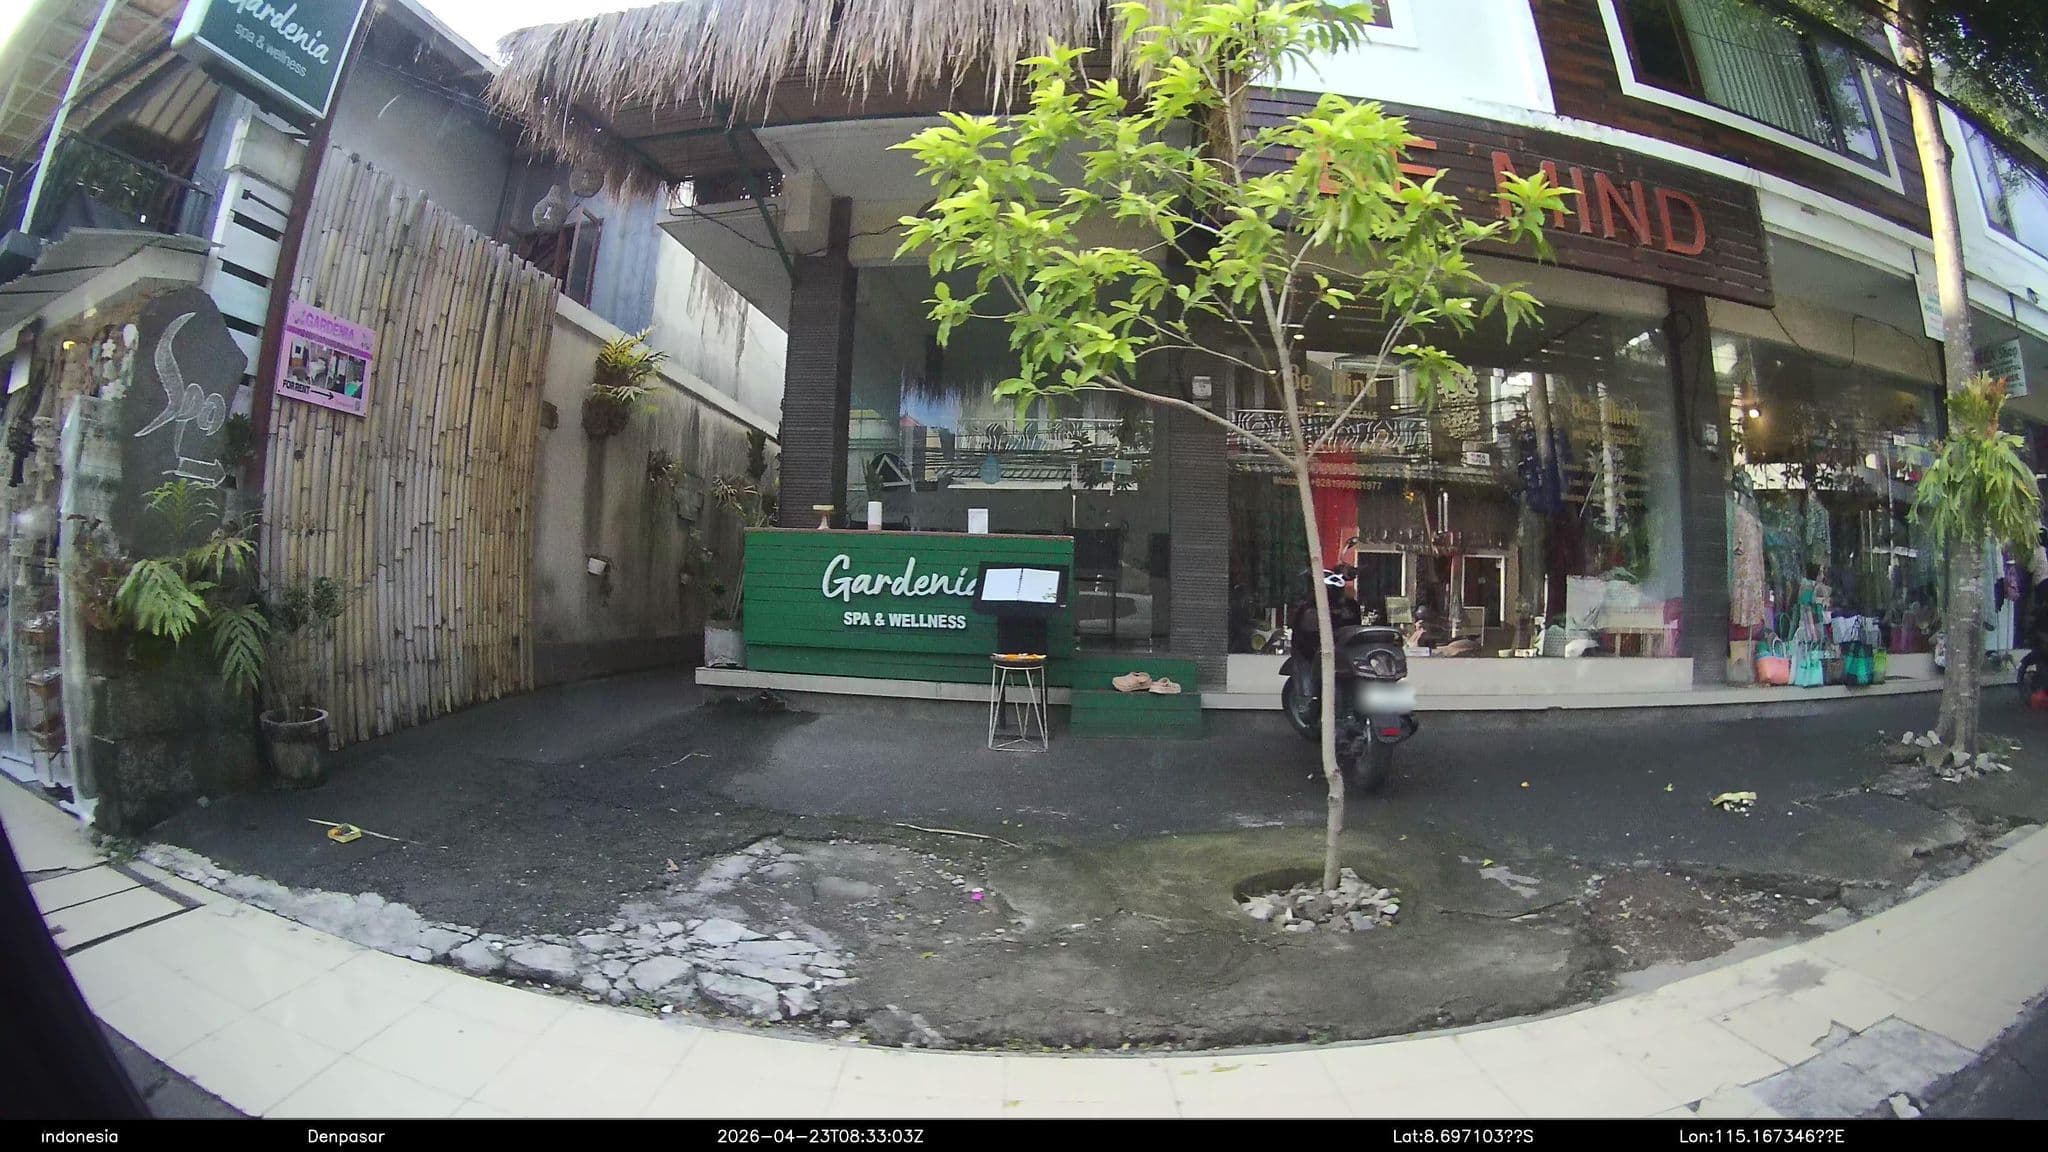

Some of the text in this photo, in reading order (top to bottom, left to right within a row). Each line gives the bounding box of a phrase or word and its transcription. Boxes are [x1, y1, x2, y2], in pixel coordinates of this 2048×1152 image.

[234, 23, 307, 77] spa & wellness
[1491, 151, 1706, 256] MIND
[282, 379, 311, 395] FOR RENT
[844, 611, 967, 629] SPA & WELLNESS
